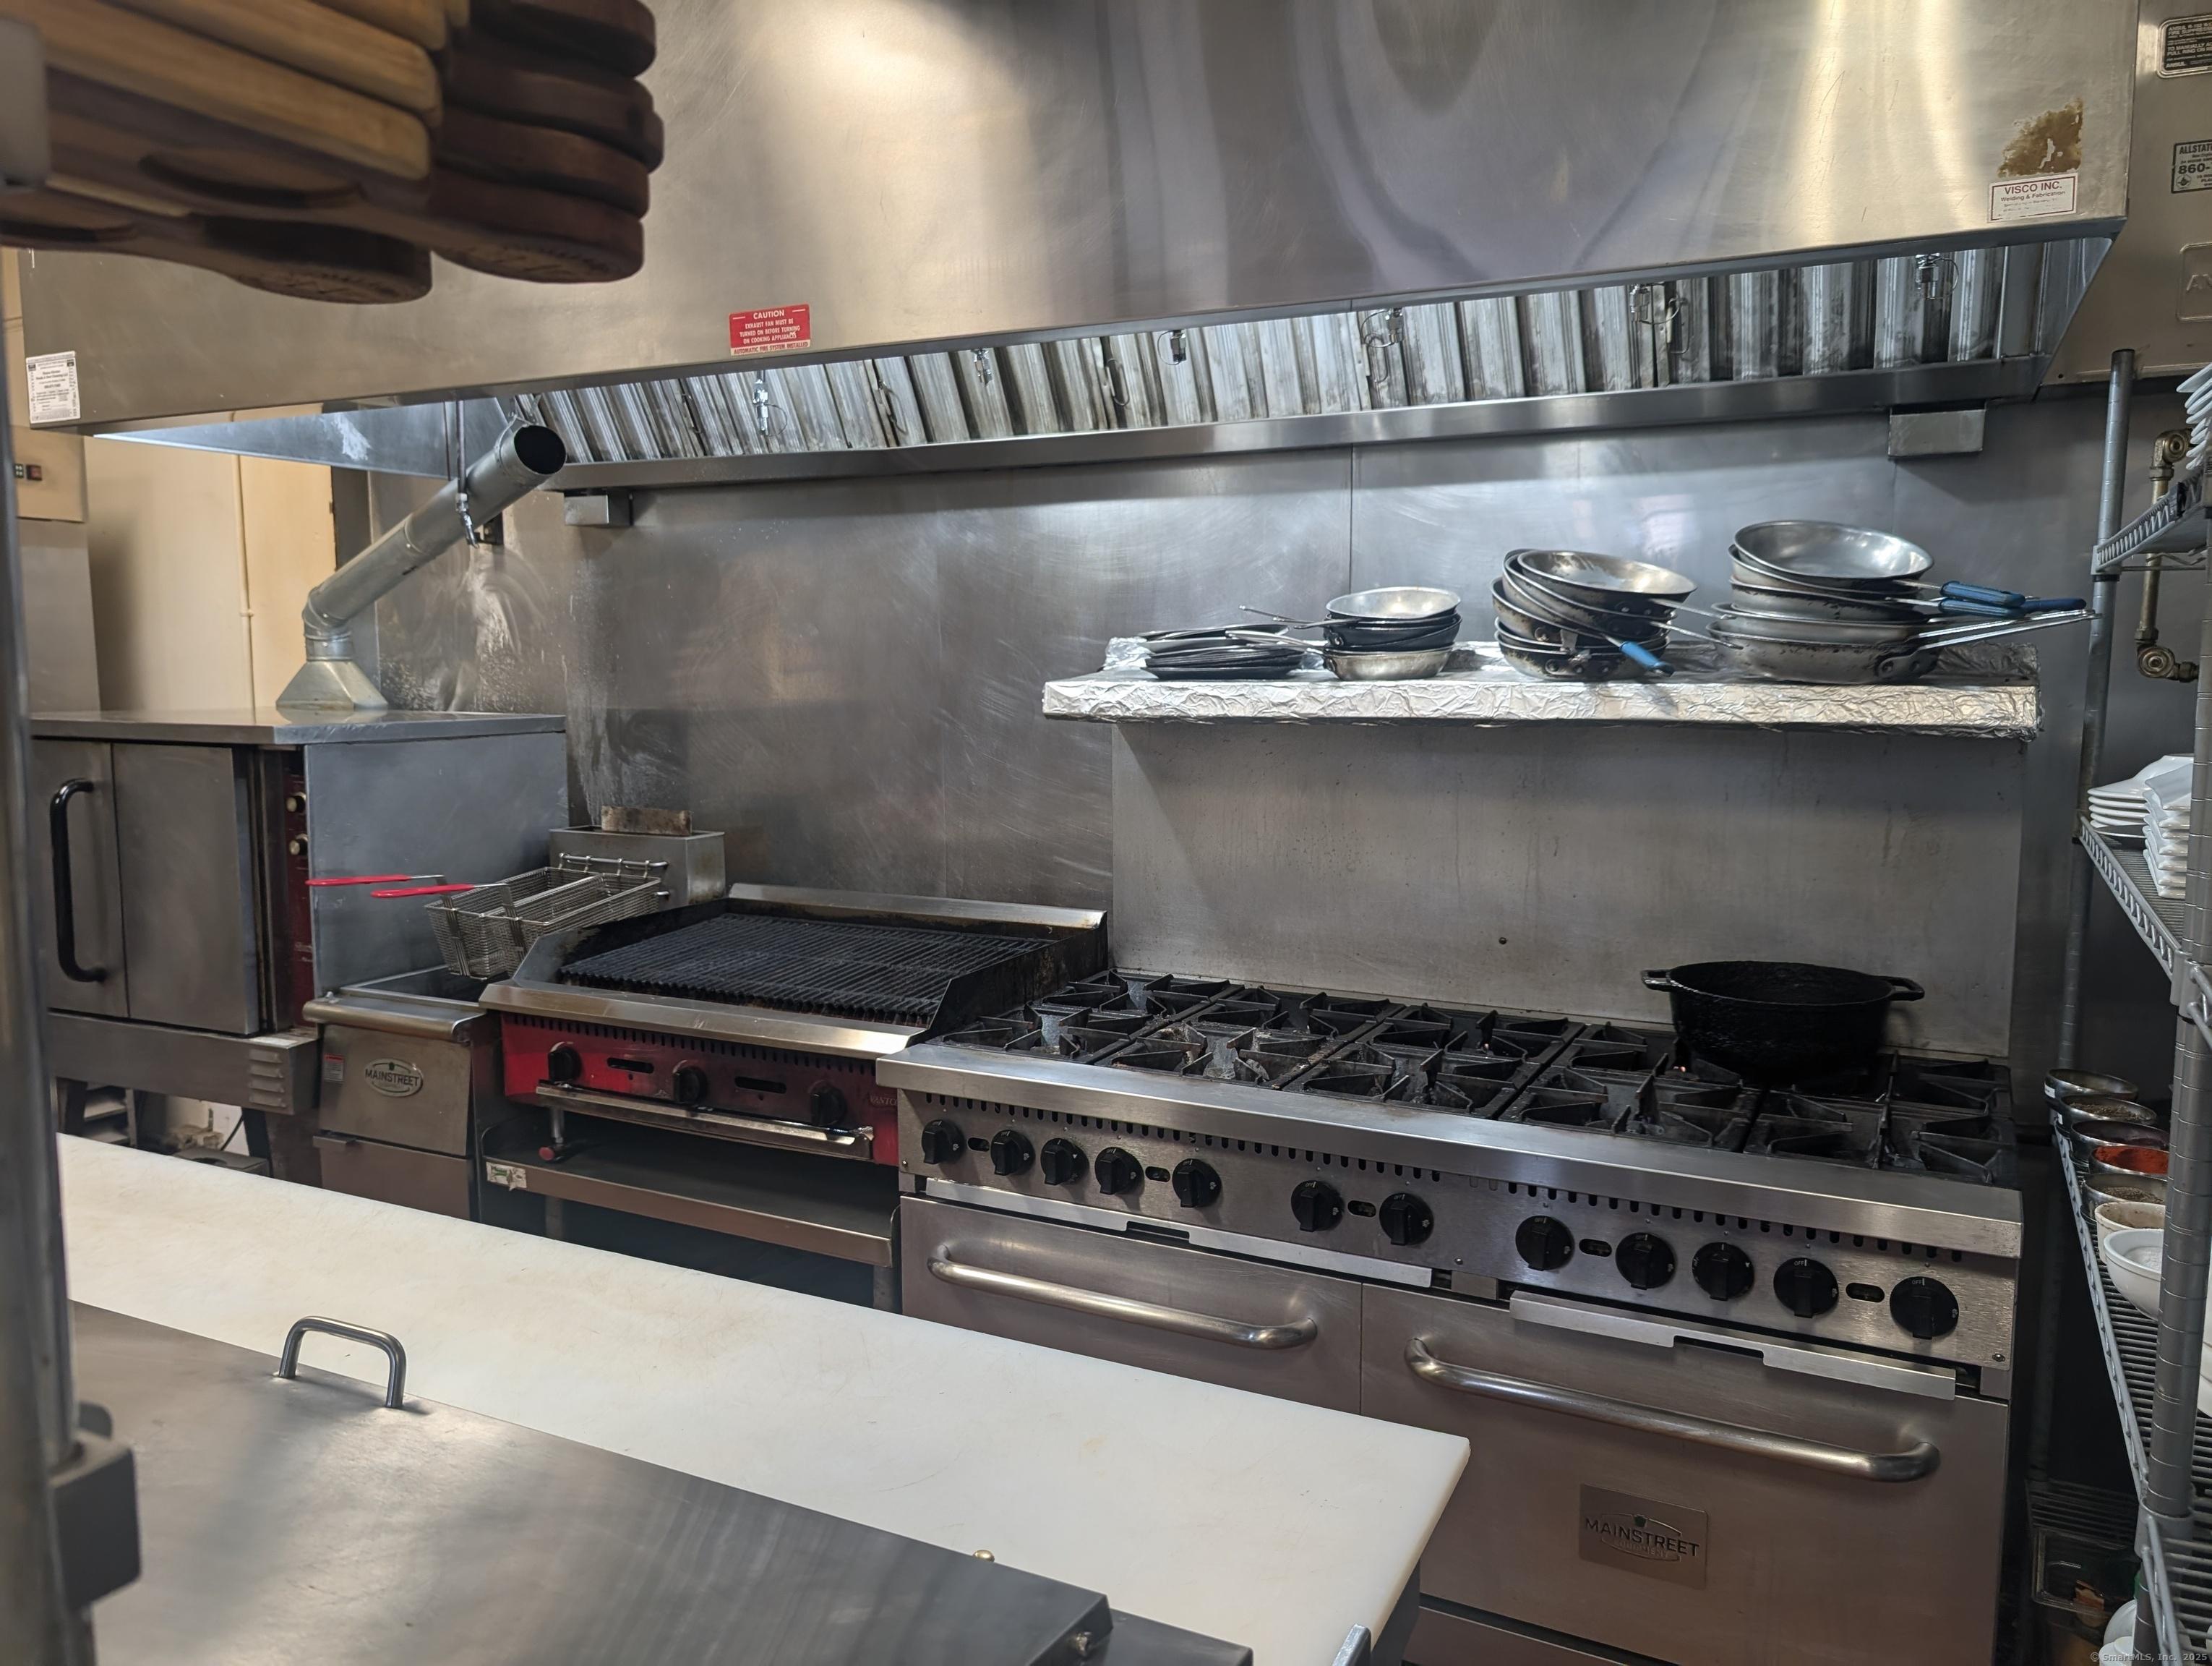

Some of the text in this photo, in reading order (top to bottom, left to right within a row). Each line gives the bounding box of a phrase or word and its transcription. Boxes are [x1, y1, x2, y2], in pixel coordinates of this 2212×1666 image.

[2005, 181, 2062, 195] VISCO INC.
[2032, 190, 2065, 199] Fabrication
[753, 309, 785, 320] CAUTION
[365, 1069, 419, 1086] MAINSTREET
[1585, 1518, 1700, 1557] MAINSTREET
